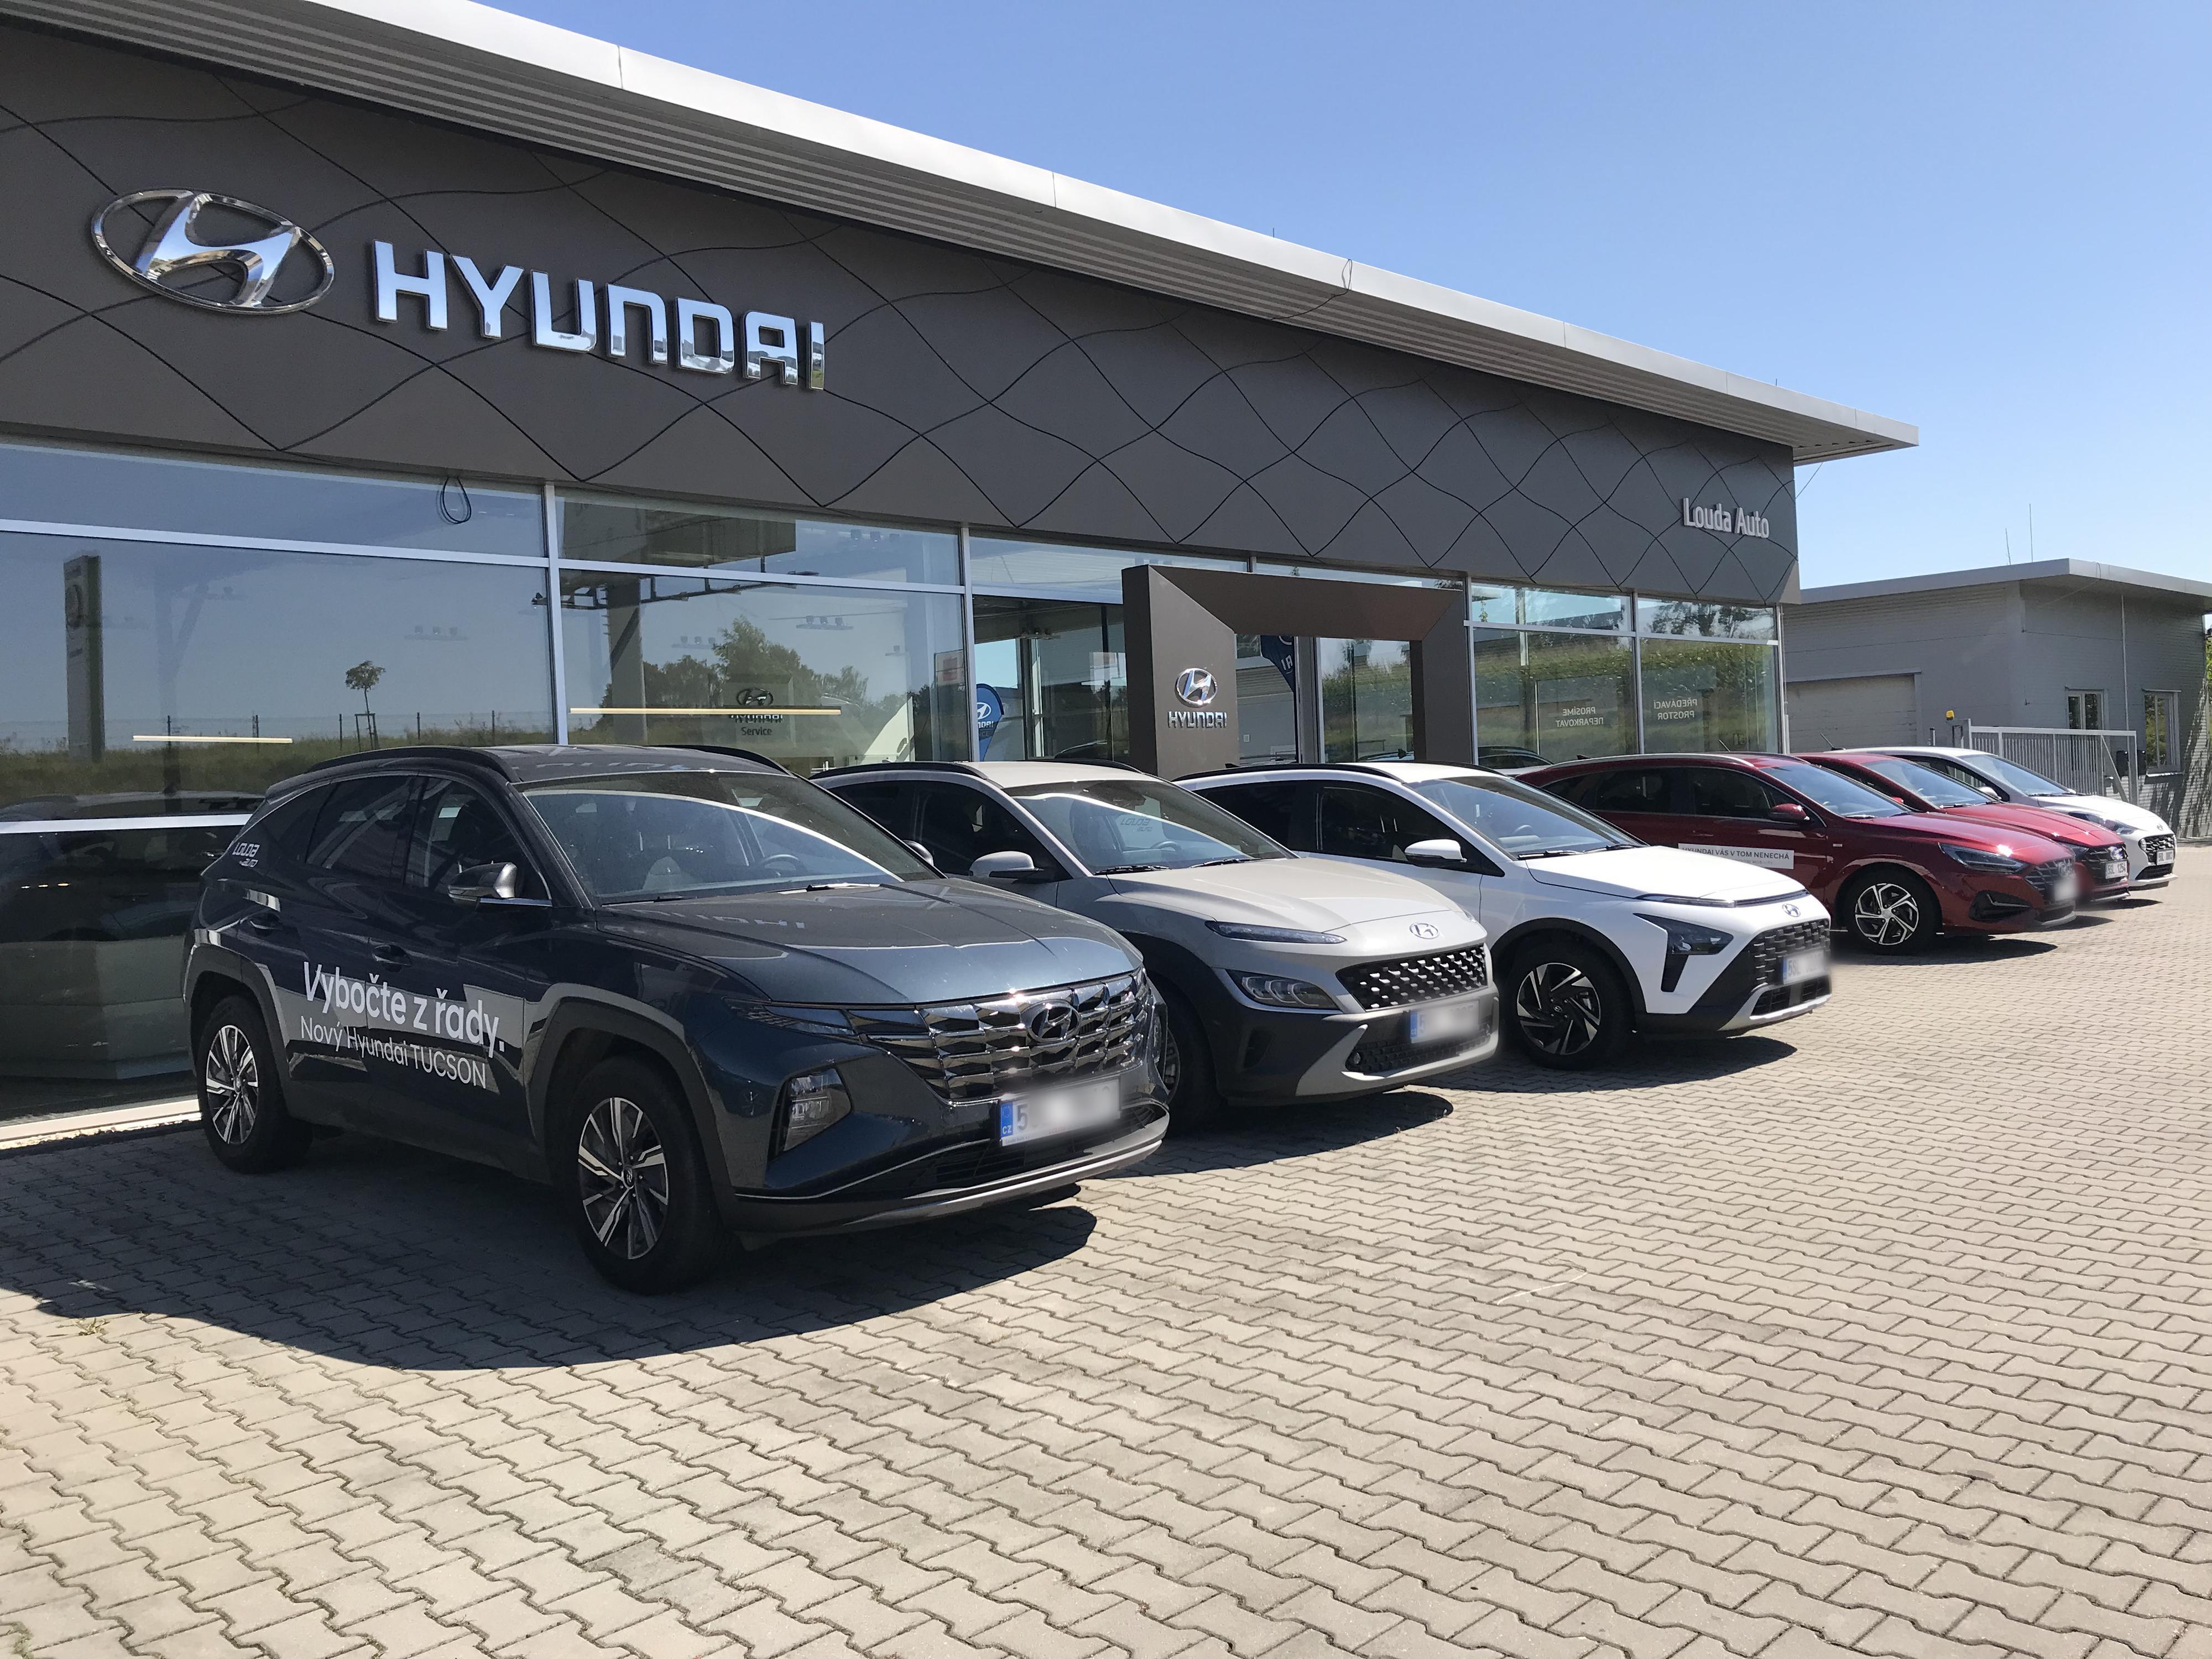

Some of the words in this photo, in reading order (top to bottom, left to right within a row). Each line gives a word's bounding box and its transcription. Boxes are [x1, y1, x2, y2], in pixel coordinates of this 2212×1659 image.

[373, 239, 825, 391] HYUNDAI
[1683, 497, 1731, 532] Louda
[1734, 507, 1770, 538] Auto
[741, 727, 773, 735] Service
[1168, 711, 1227, 728] HYUNDAI
[303, 961, 406, 1025] Vybočte
[413, 996, 427, 1031] z
[435, 988, 505, 1058] řady.
[300, 1015, 343, 1052] Nový
[346, 1026, 408, 1066] Hyundai
[410, 1044, 487, 1089] TUCSON
[1002, 1125, 1012, 1135] CZ
